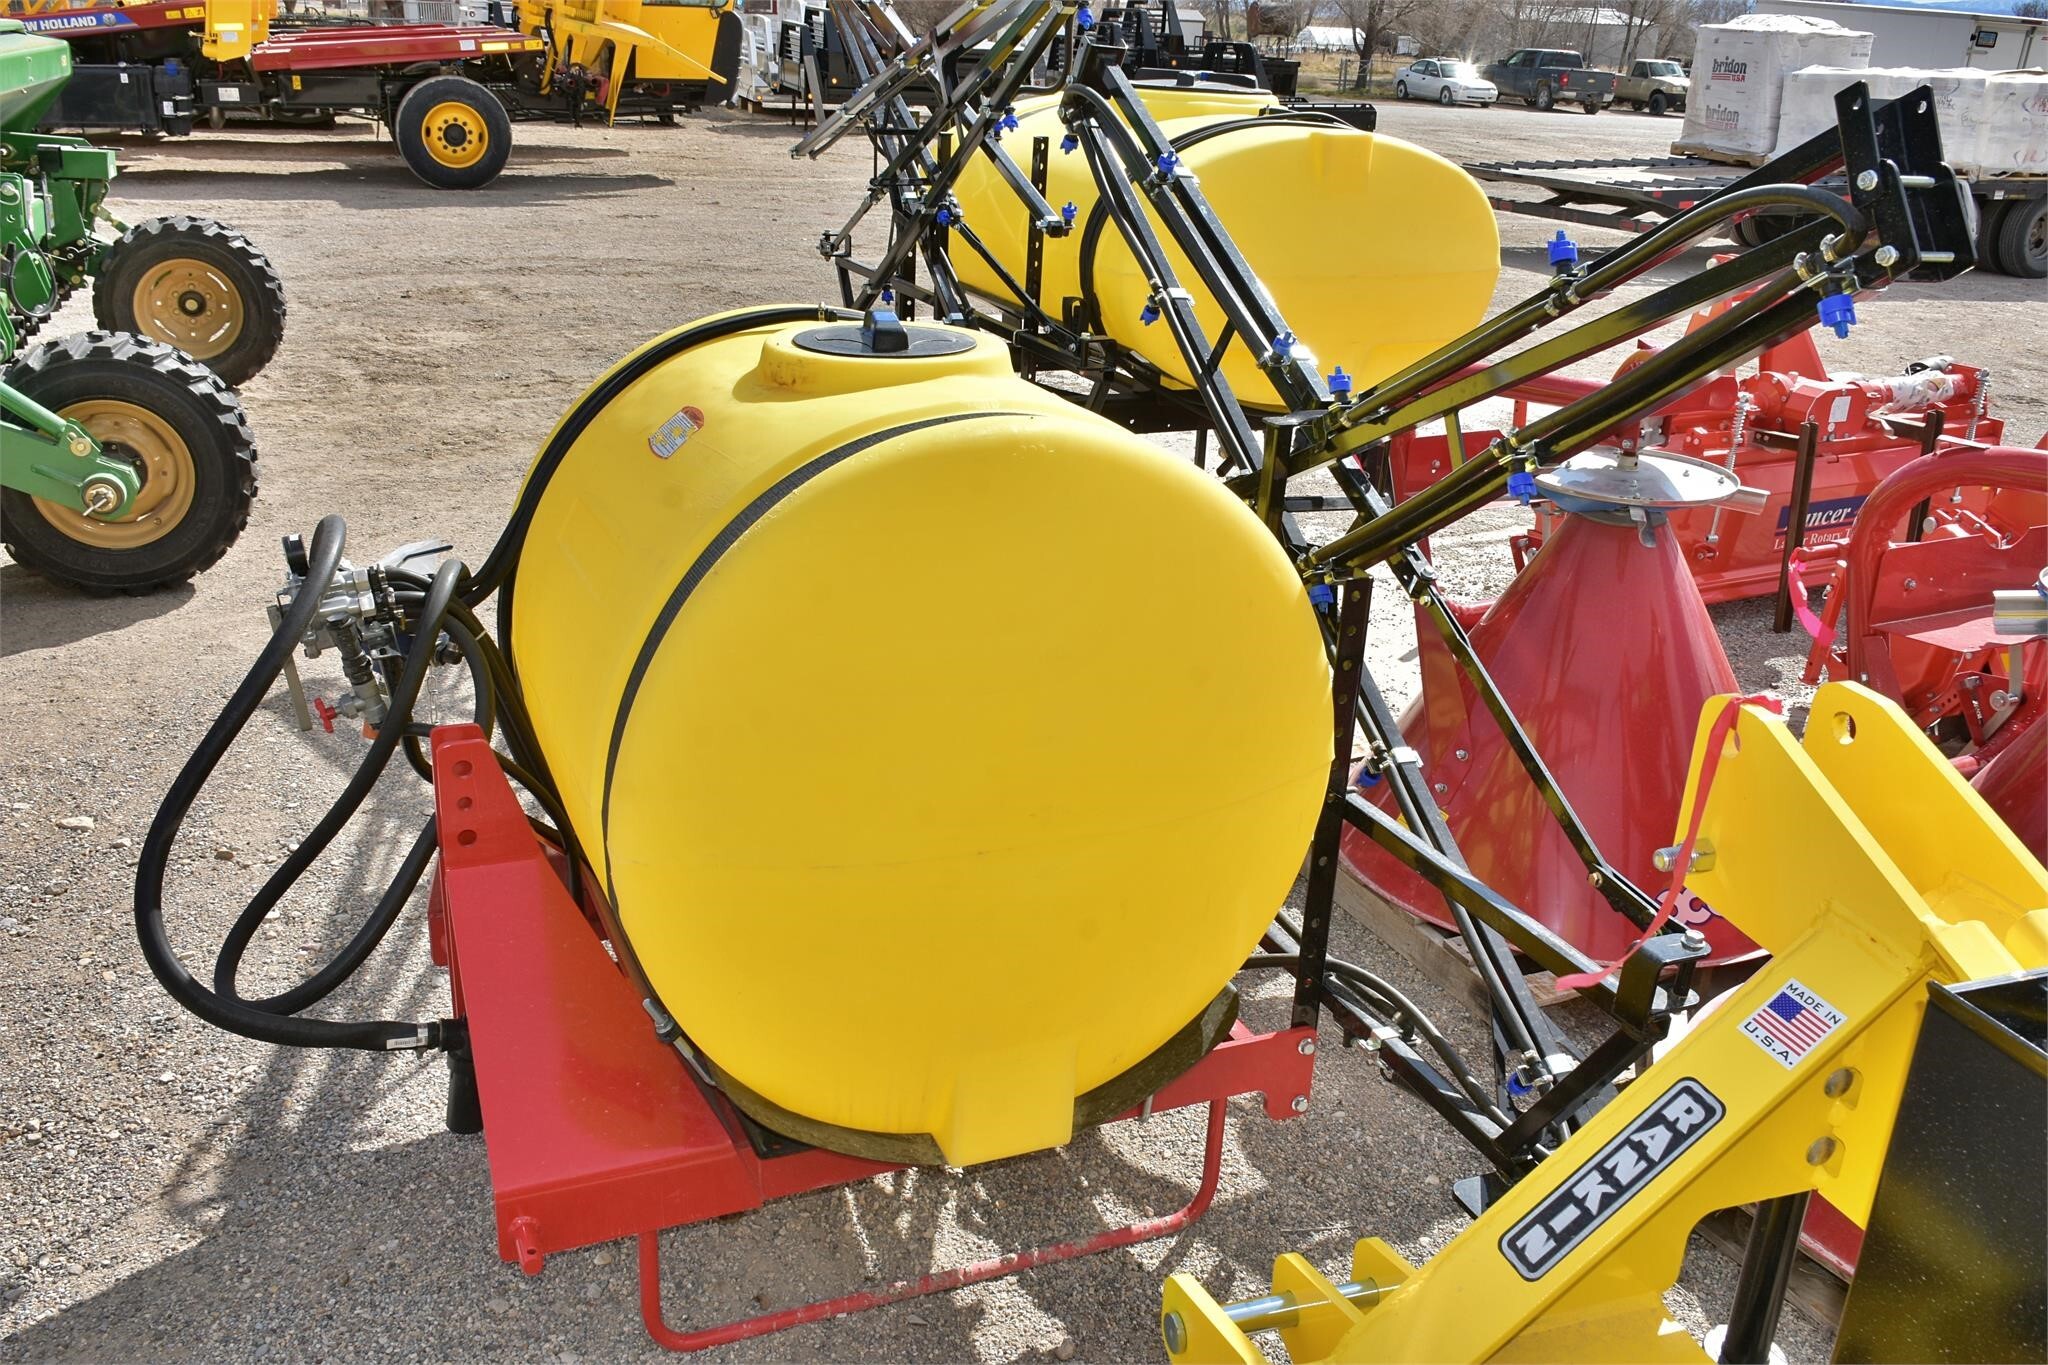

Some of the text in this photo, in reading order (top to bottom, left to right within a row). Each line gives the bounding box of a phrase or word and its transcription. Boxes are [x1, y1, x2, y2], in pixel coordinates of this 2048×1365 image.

[40, 16, 97, 30] HOLLAND
[1712, 56, 1747, 74] bridon
[1731, 74, 1745, 82] USA
[1705, 104, 1739, 122] bridon
[1786, 983, 1841, 1025] MADE IN
[1743, 1021, 1793, 1065] U.S.A.
[1515, 1092, 1706, 1265] RANKIN
